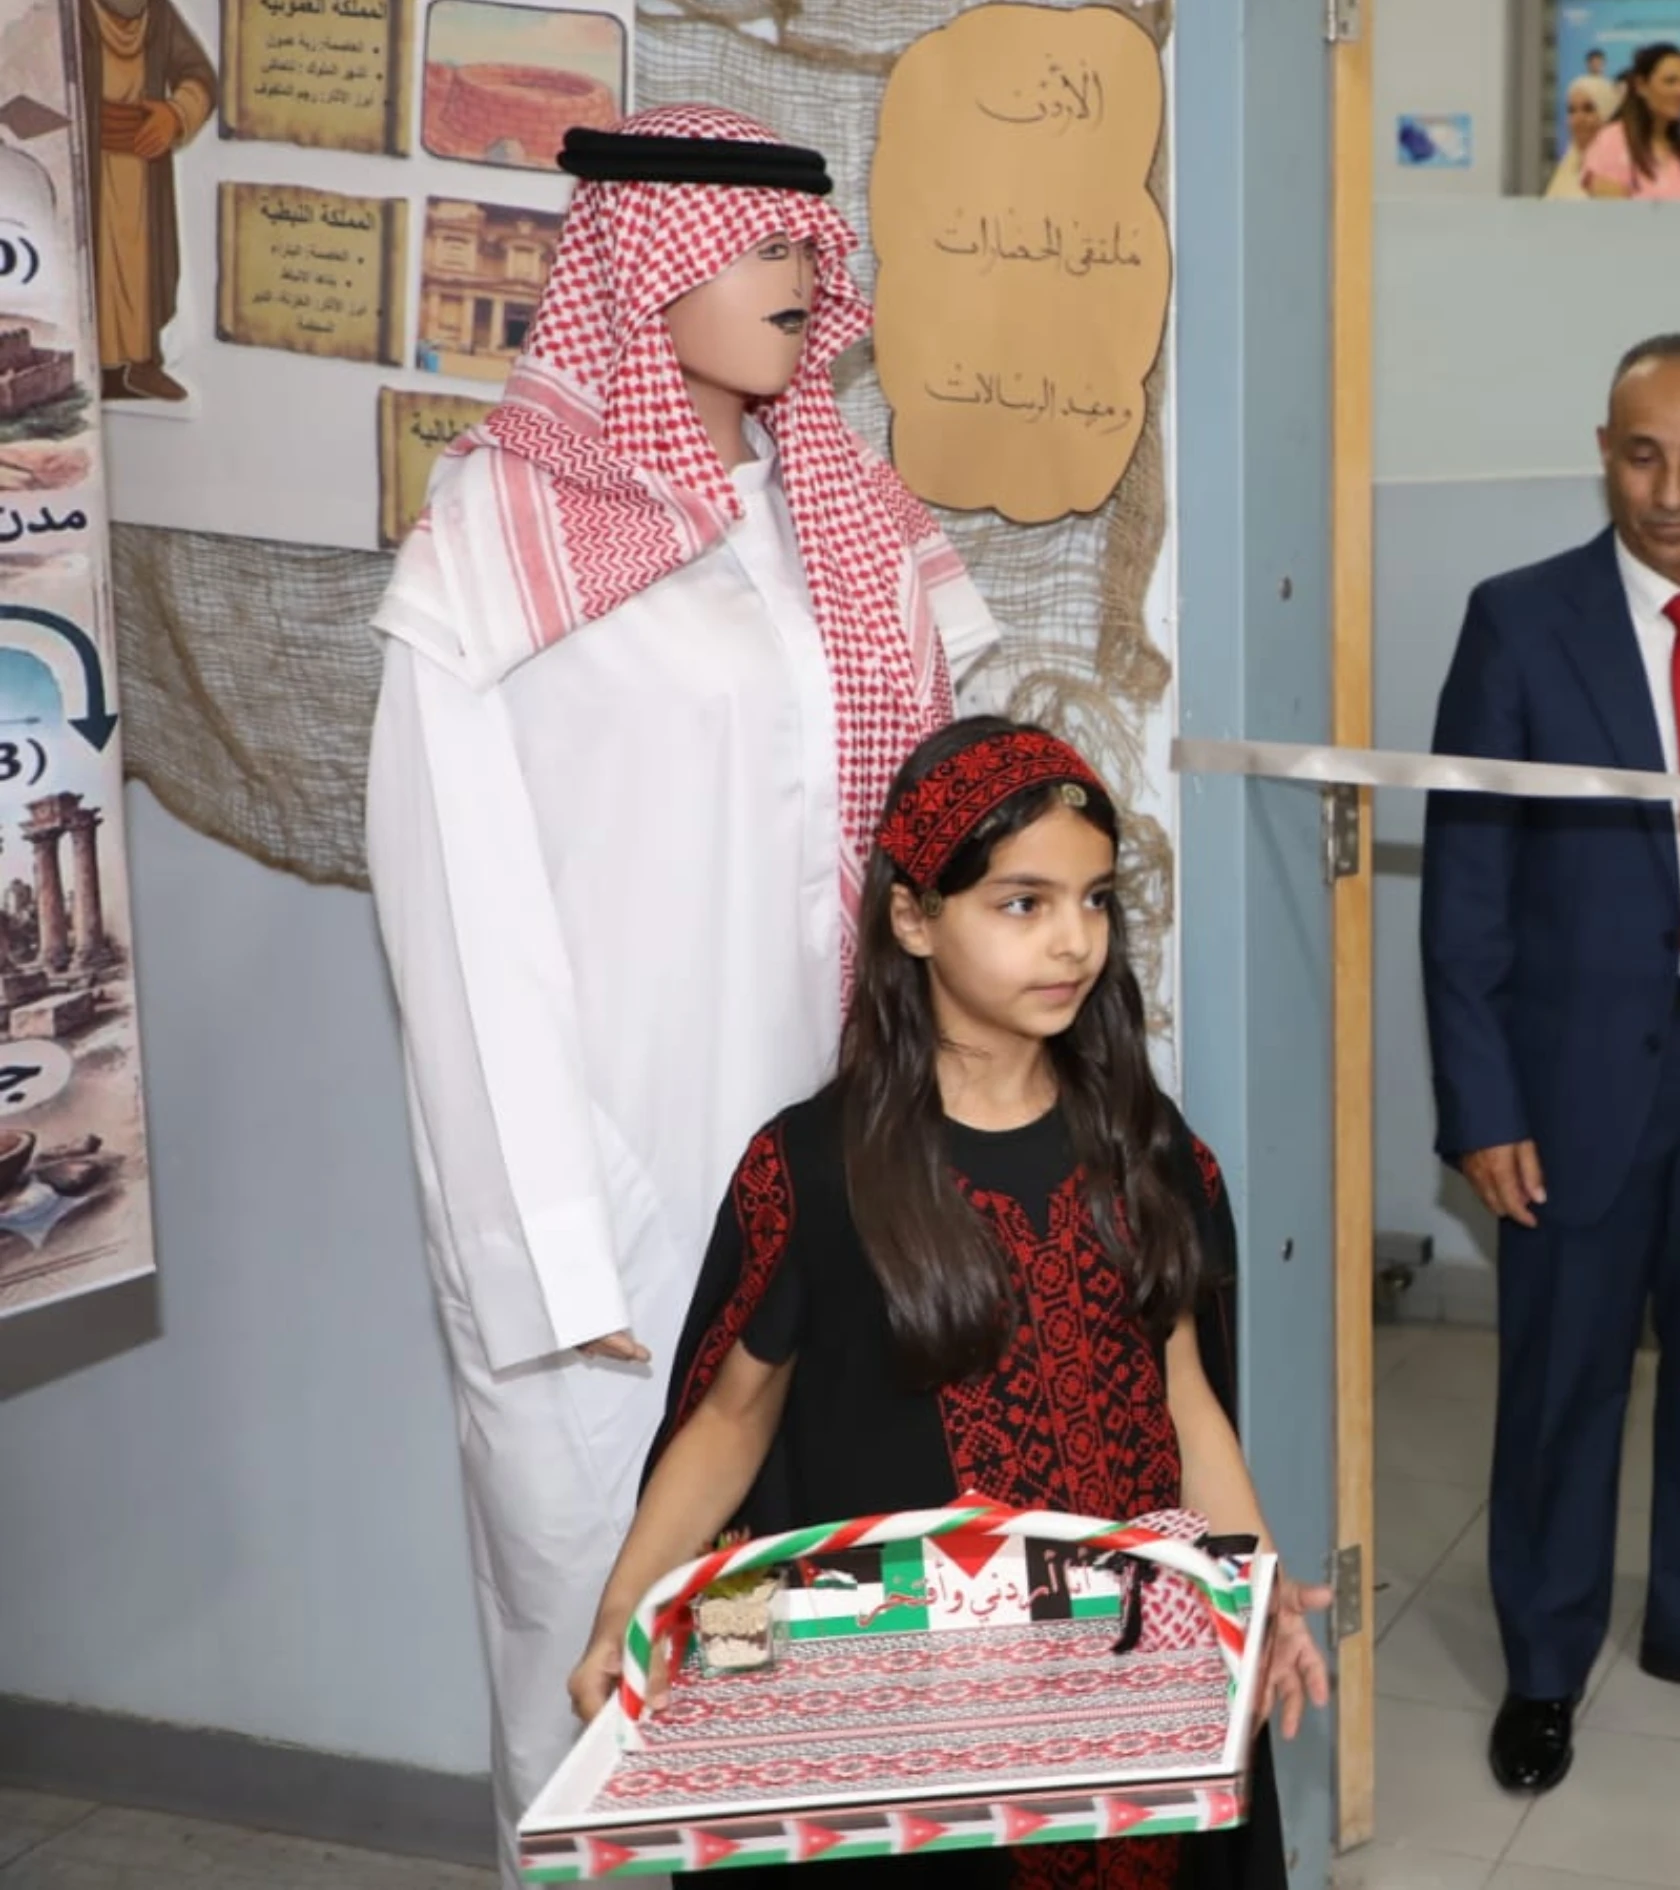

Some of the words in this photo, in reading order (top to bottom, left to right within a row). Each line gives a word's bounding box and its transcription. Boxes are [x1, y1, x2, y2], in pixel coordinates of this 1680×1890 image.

[260, 195, 314, 229] النبطية
[320, 200, 375, 232] المملكة
[934, 208, 1062, 277] الحضارات
[924, 362, 1055, 423] الرسالات
[856, 1558, 964, 1628] وأفتخر
[969, 1548, 1058, 1623] أردني
